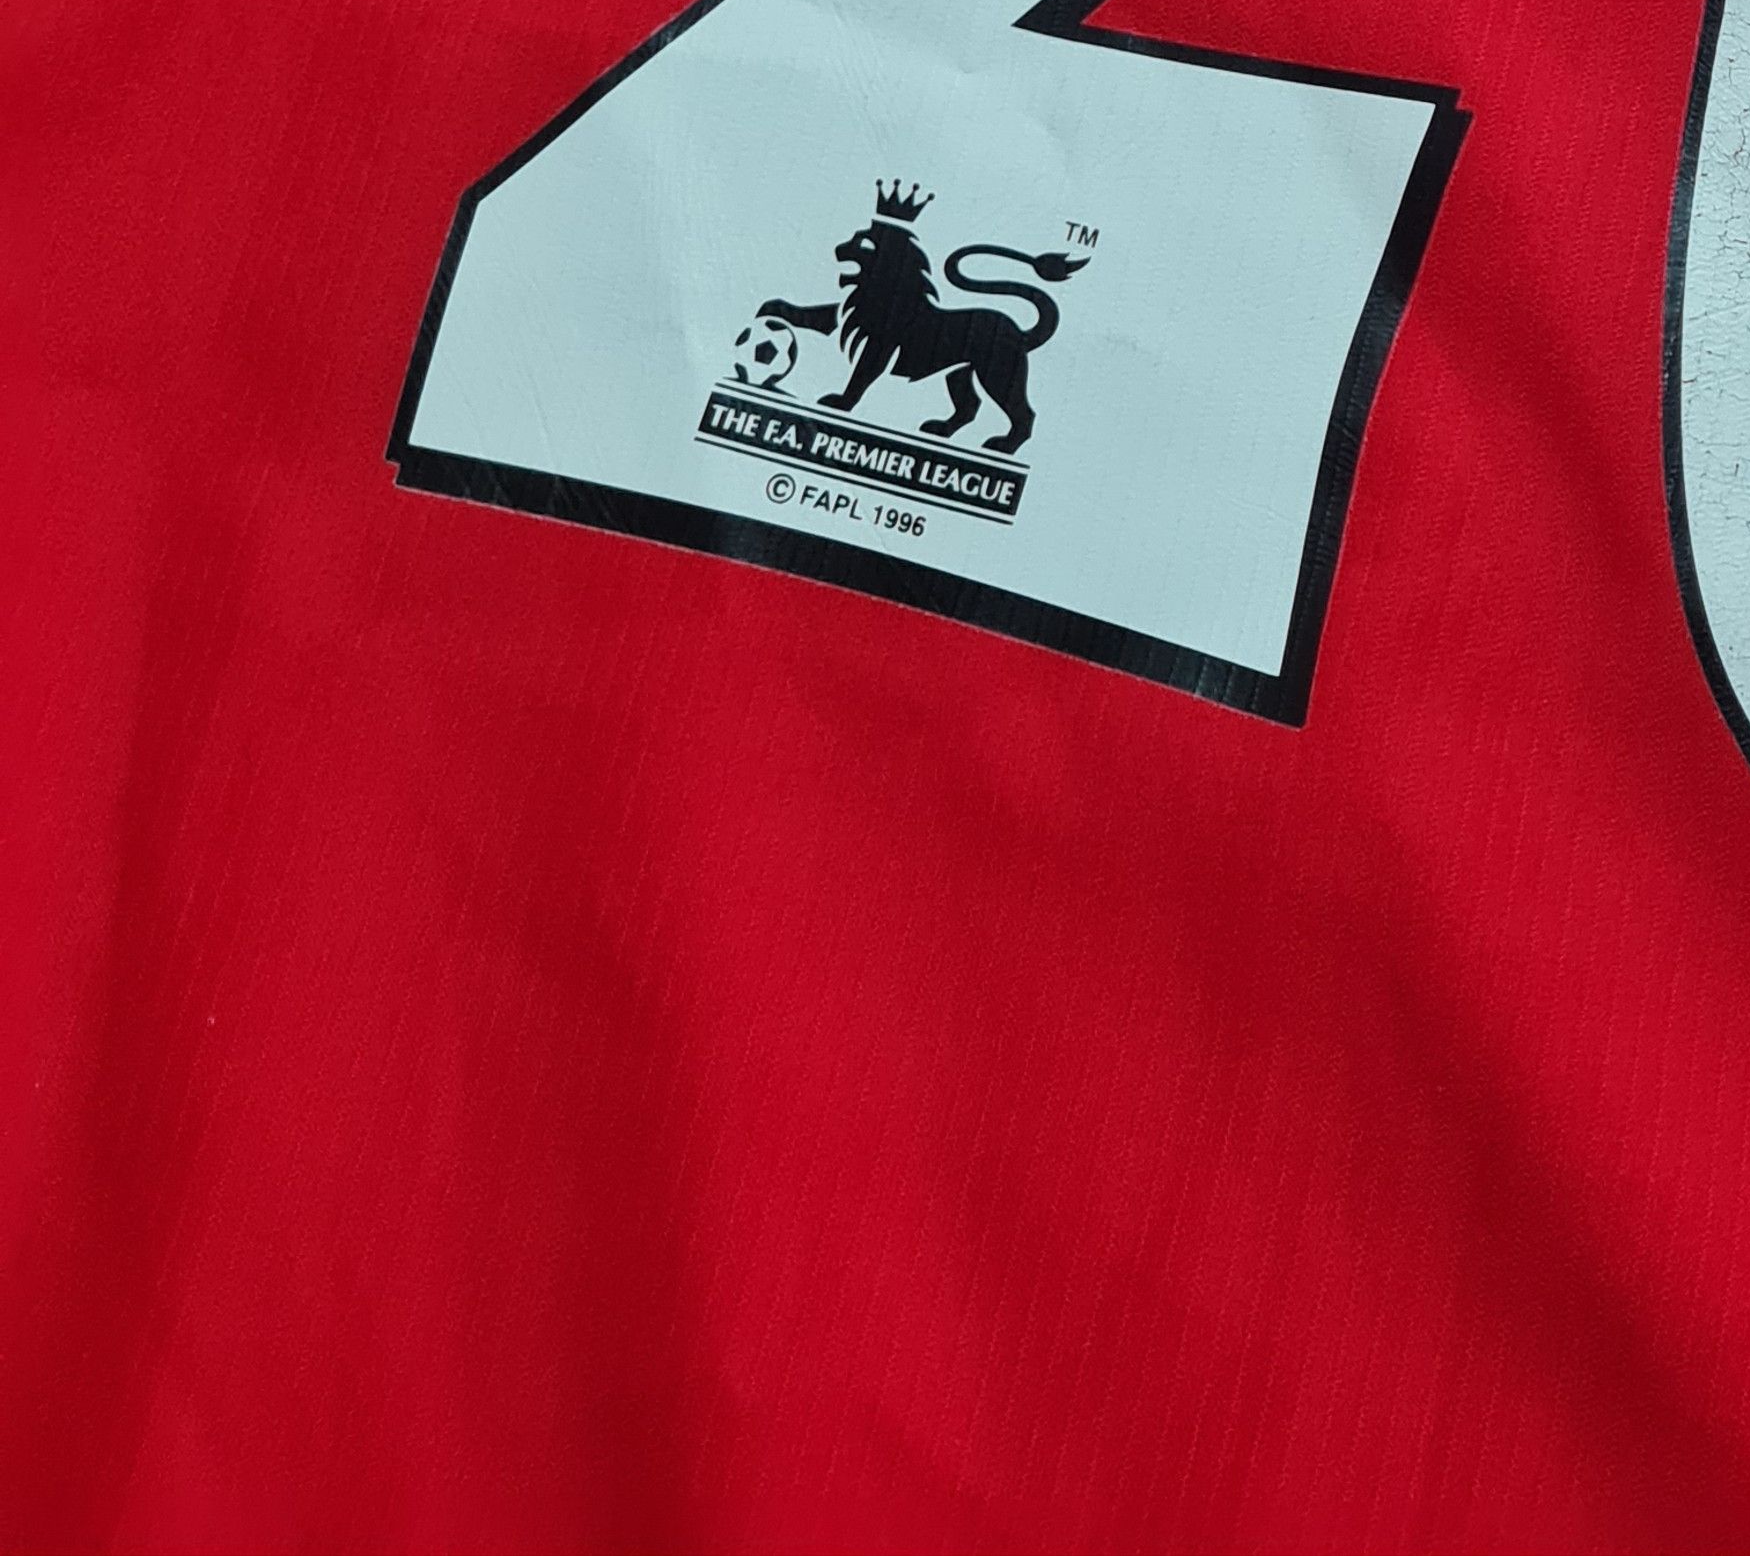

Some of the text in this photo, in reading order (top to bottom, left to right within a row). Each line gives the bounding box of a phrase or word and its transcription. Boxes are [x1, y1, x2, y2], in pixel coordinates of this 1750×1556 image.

[1065, 221, 1100, 248] TM
[710, 404, 1016, 506] THE F.A. PREMIER LEAGUE
[873, 503, 927, 537] 1996
